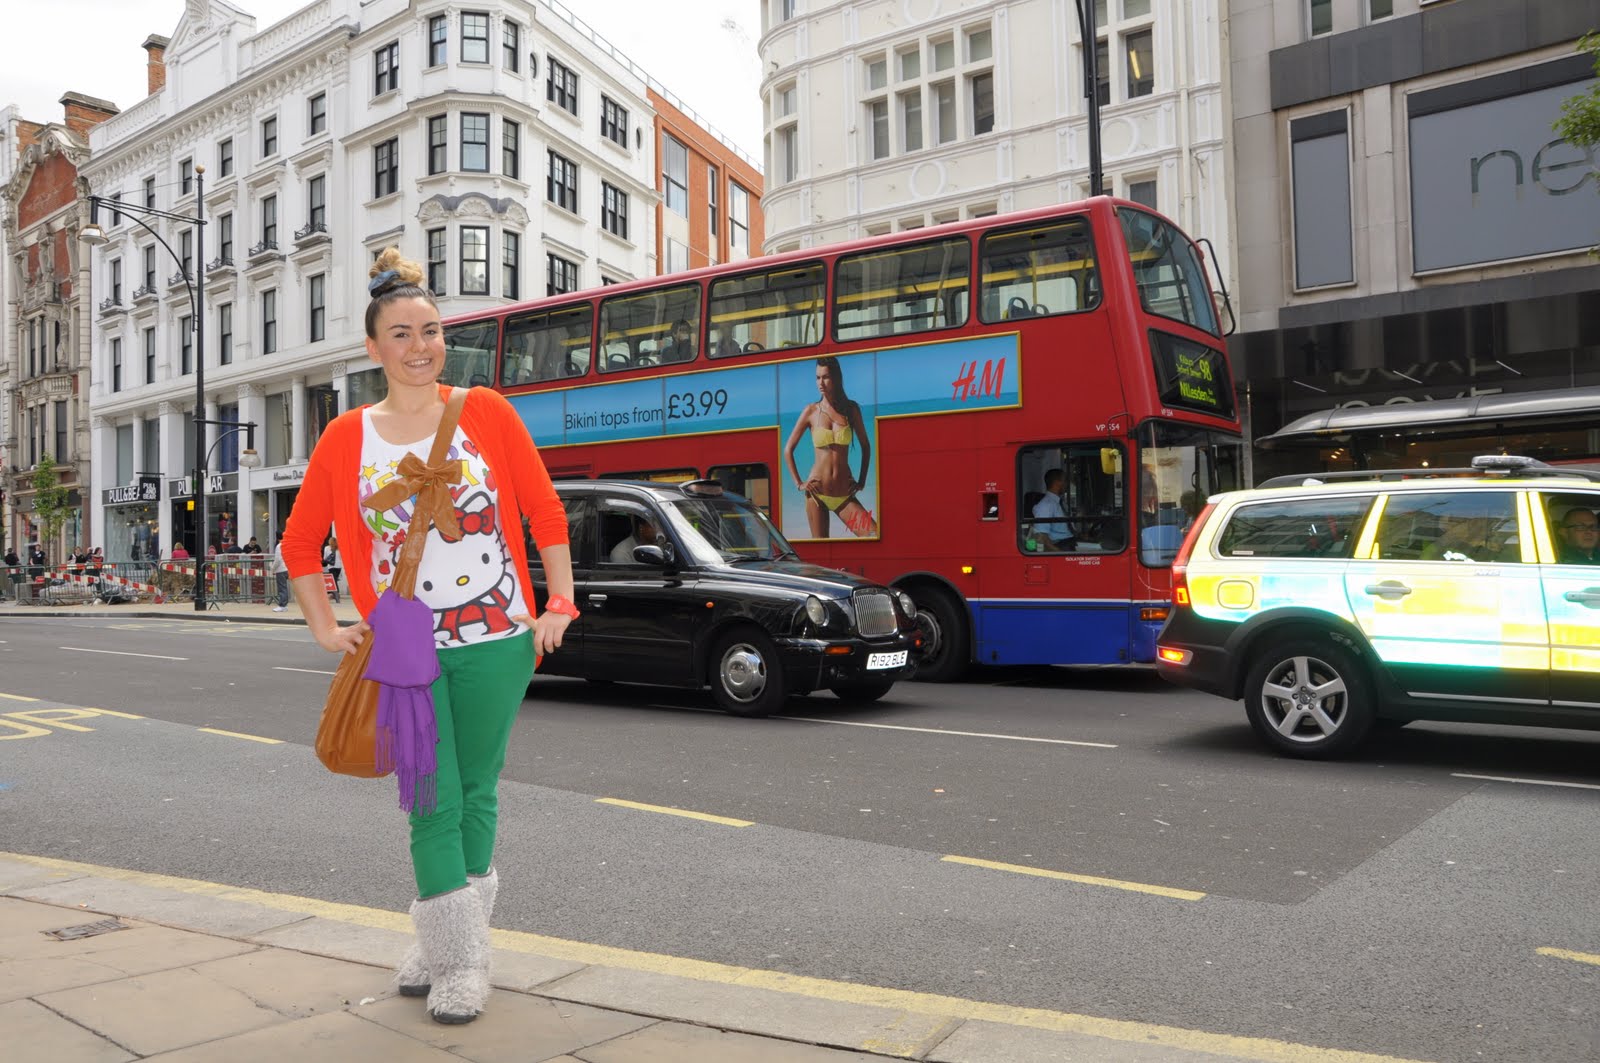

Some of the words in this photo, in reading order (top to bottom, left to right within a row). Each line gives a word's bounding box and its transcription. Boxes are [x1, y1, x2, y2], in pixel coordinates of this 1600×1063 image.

[1470, 137, 1597, 207] ne
[952, 357, 1006, 402] H&M
[1199, 359, 1212, 381] 98
[565, 411, 597, 430] Bikini
[600, 412, 630, 429] tops
[632, 407, 664, 423] from
[667, 388, 728, 419] £3.99
[1095, 423, 1106, 432] VP
[108, 486, 140, 503] PULL&BEA
[869, 654, 891, 667] R192
